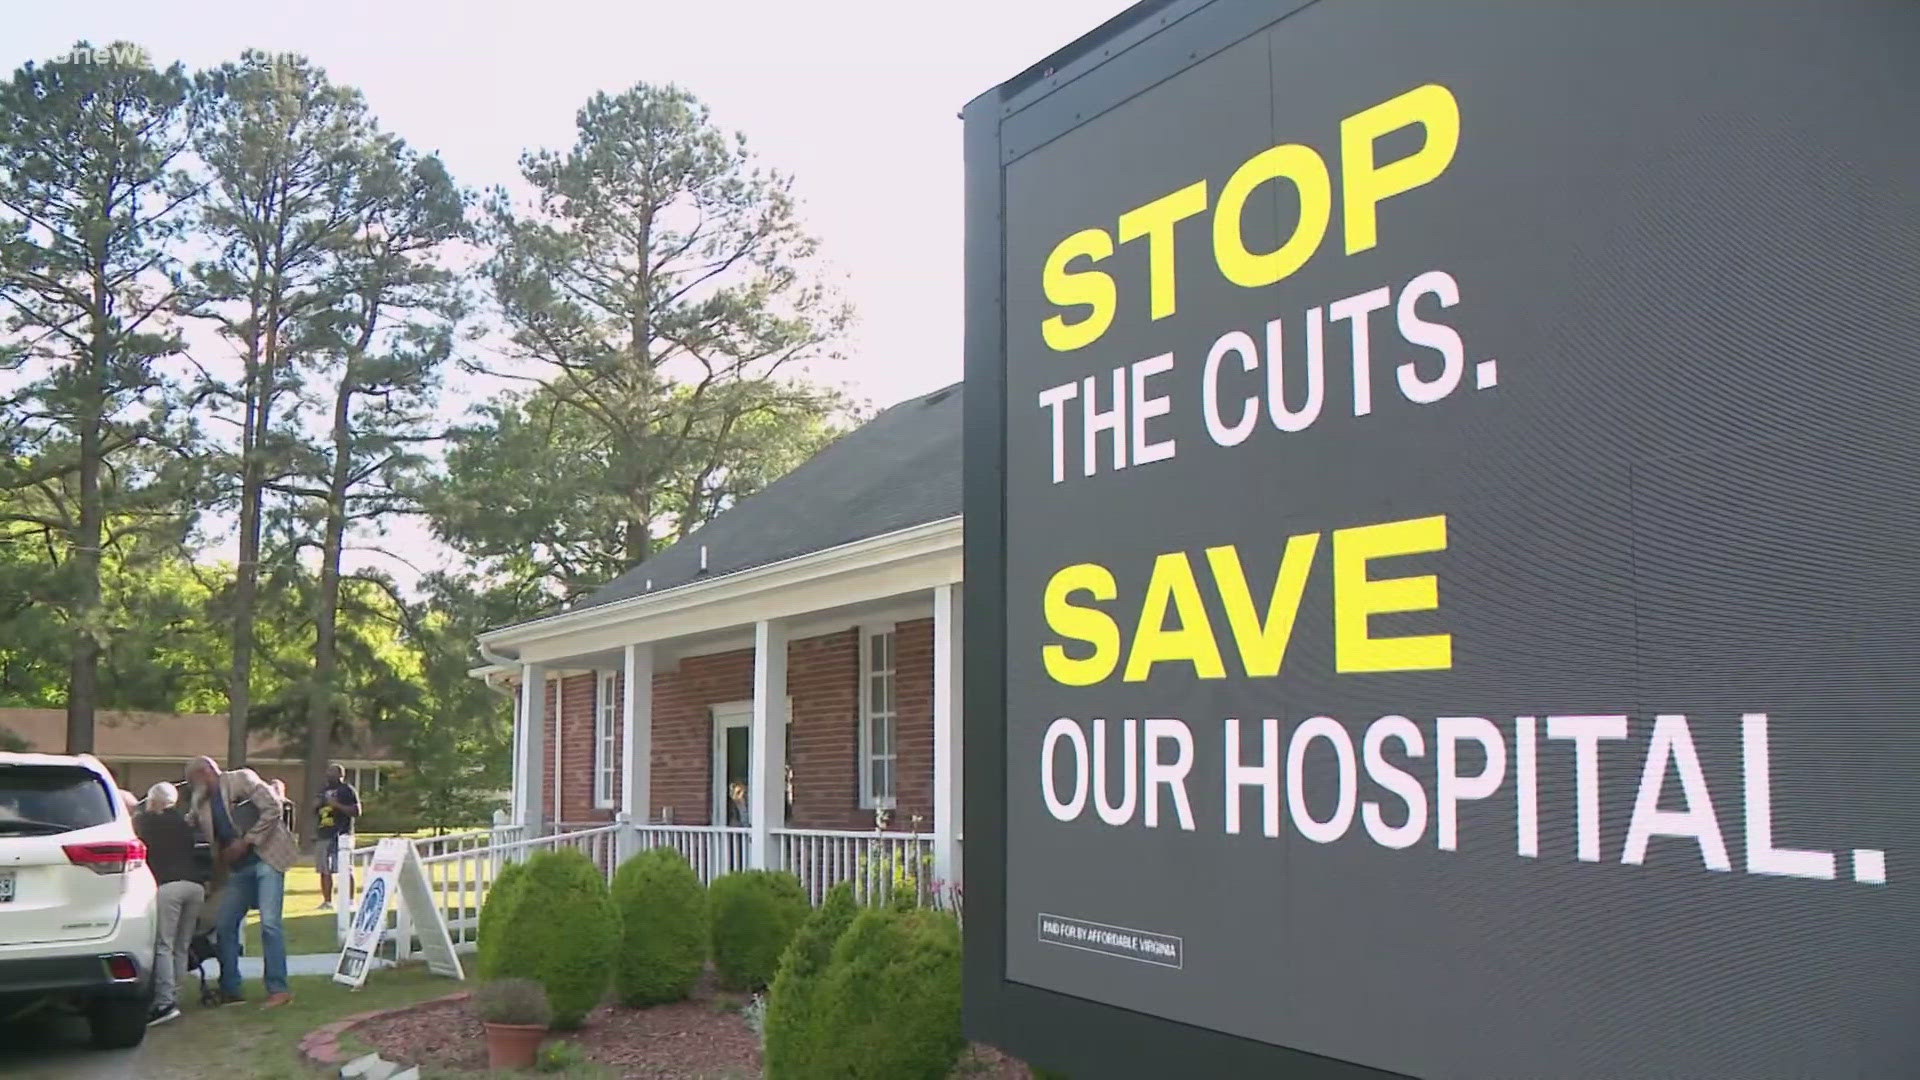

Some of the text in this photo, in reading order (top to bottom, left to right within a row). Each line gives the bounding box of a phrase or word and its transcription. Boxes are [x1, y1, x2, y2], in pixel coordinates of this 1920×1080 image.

[1041, 83, 1461, 352] STOP
[1039, 270, 1498, 484] THE CUTS.
[1042, 515, 1453, 687] SAVE
[1040, 713, 1887, 884] OUR HOSPITAL.
[1043, 920, 1176, 957] PAID FOR BY AFFORDABLE VIRGINIA
